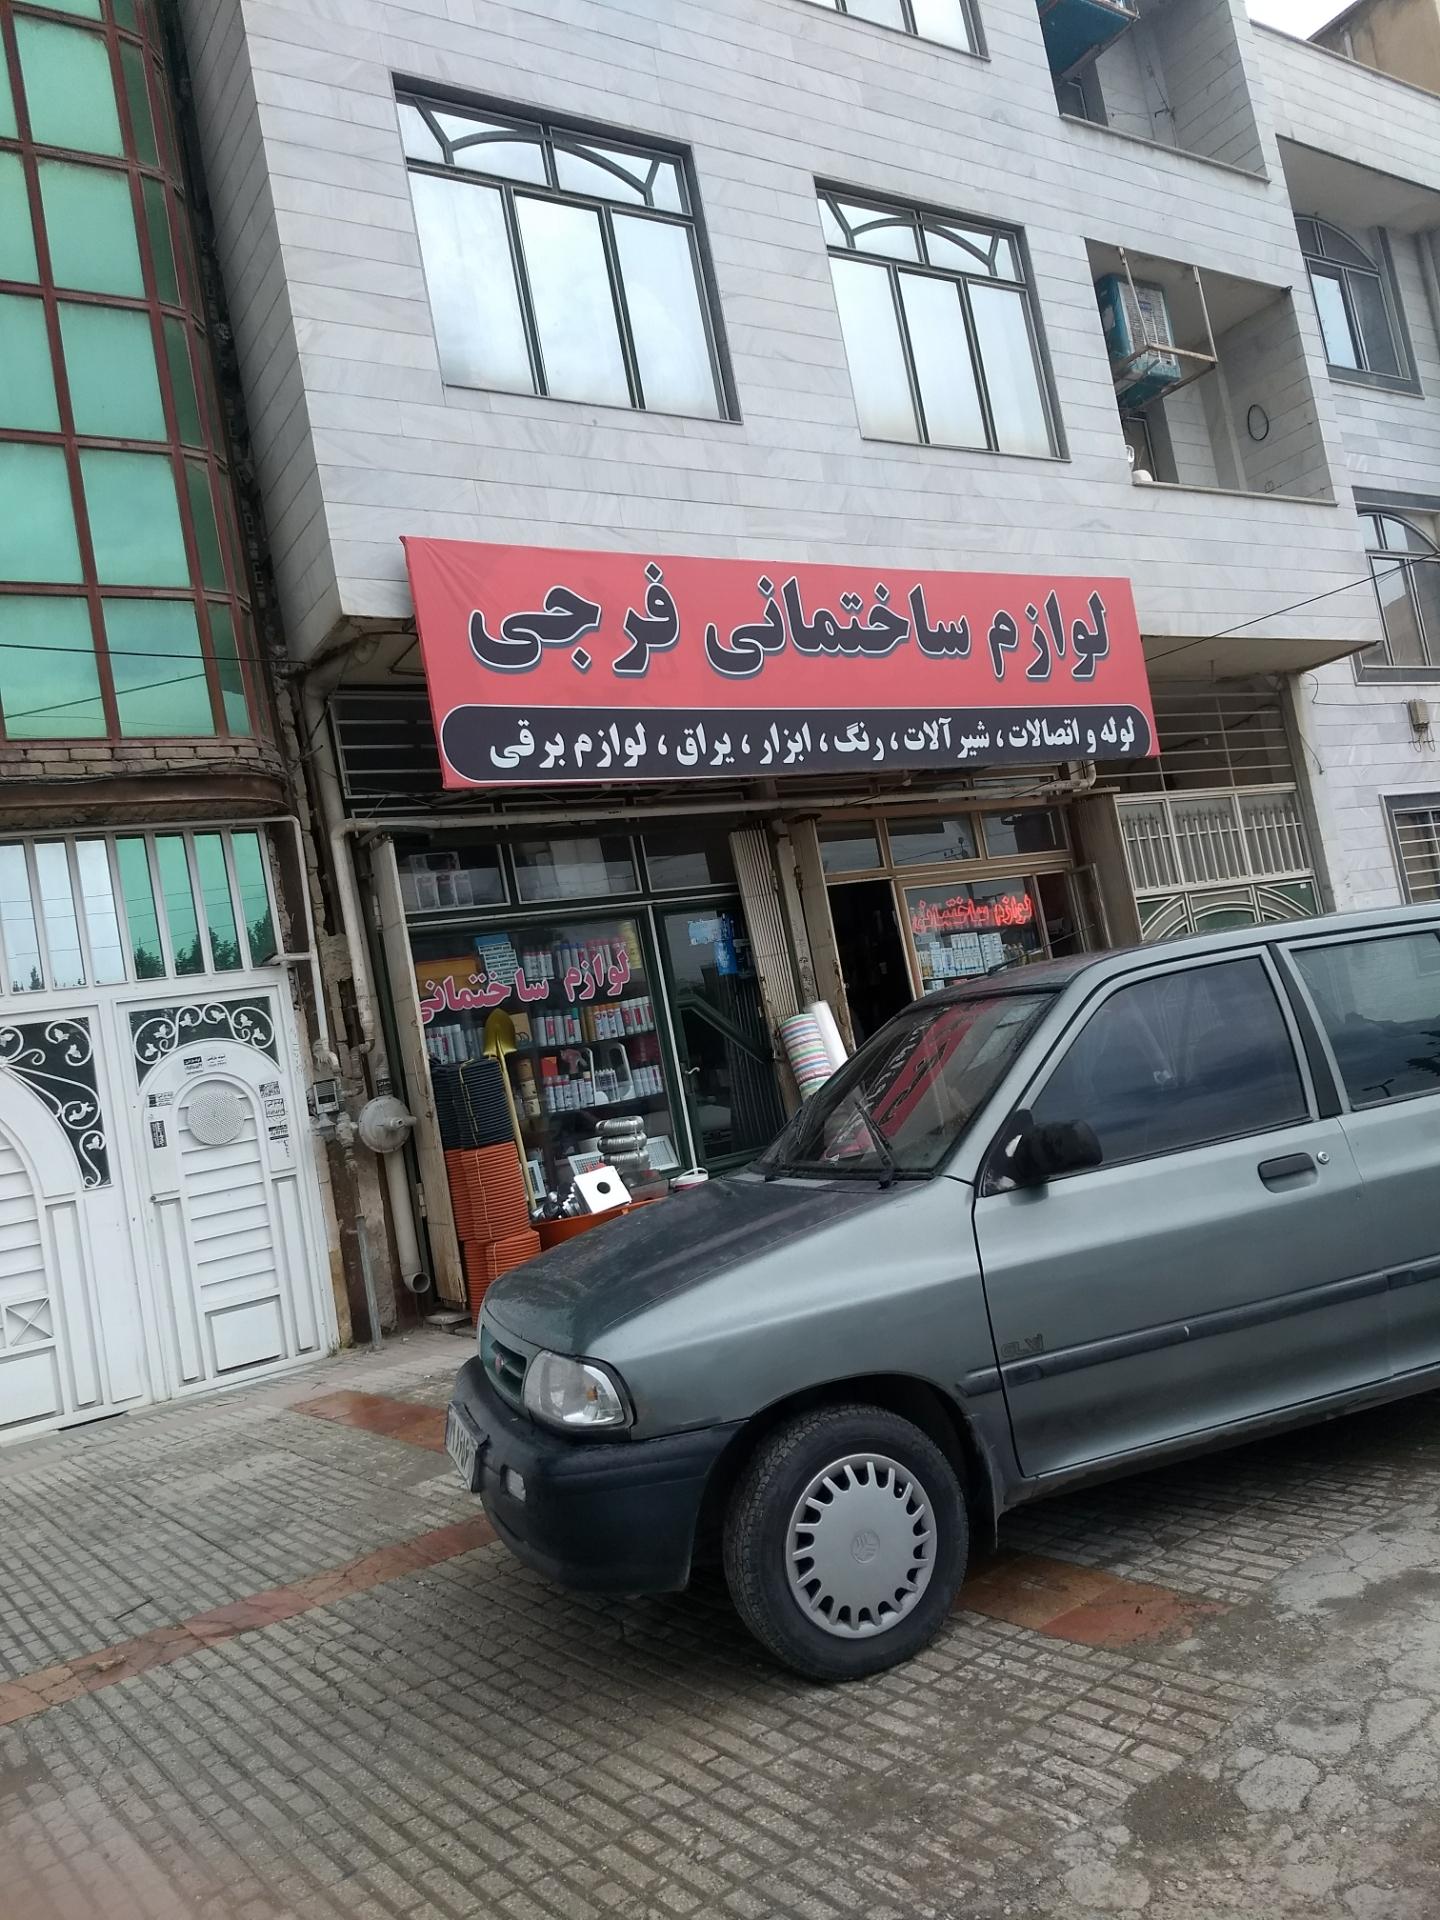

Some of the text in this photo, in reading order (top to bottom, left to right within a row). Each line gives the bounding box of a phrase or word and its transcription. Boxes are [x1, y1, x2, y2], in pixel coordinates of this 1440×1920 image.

[468, 561, 1109, 681] لوازم ساختمانی فرجی
[489, 719, 565, 769] برقی
[573, 721, 648, 768] لوازم
[676, 721, 735, 767] یراق
[759, 721, 813, 765] ابزار
[1086, 727, 1098, 753] و
[1100, 716, 1136, 752] لوله
[994, 893, 1033, 927] لوازم
[563, 950, 631, 1003] لوازم
